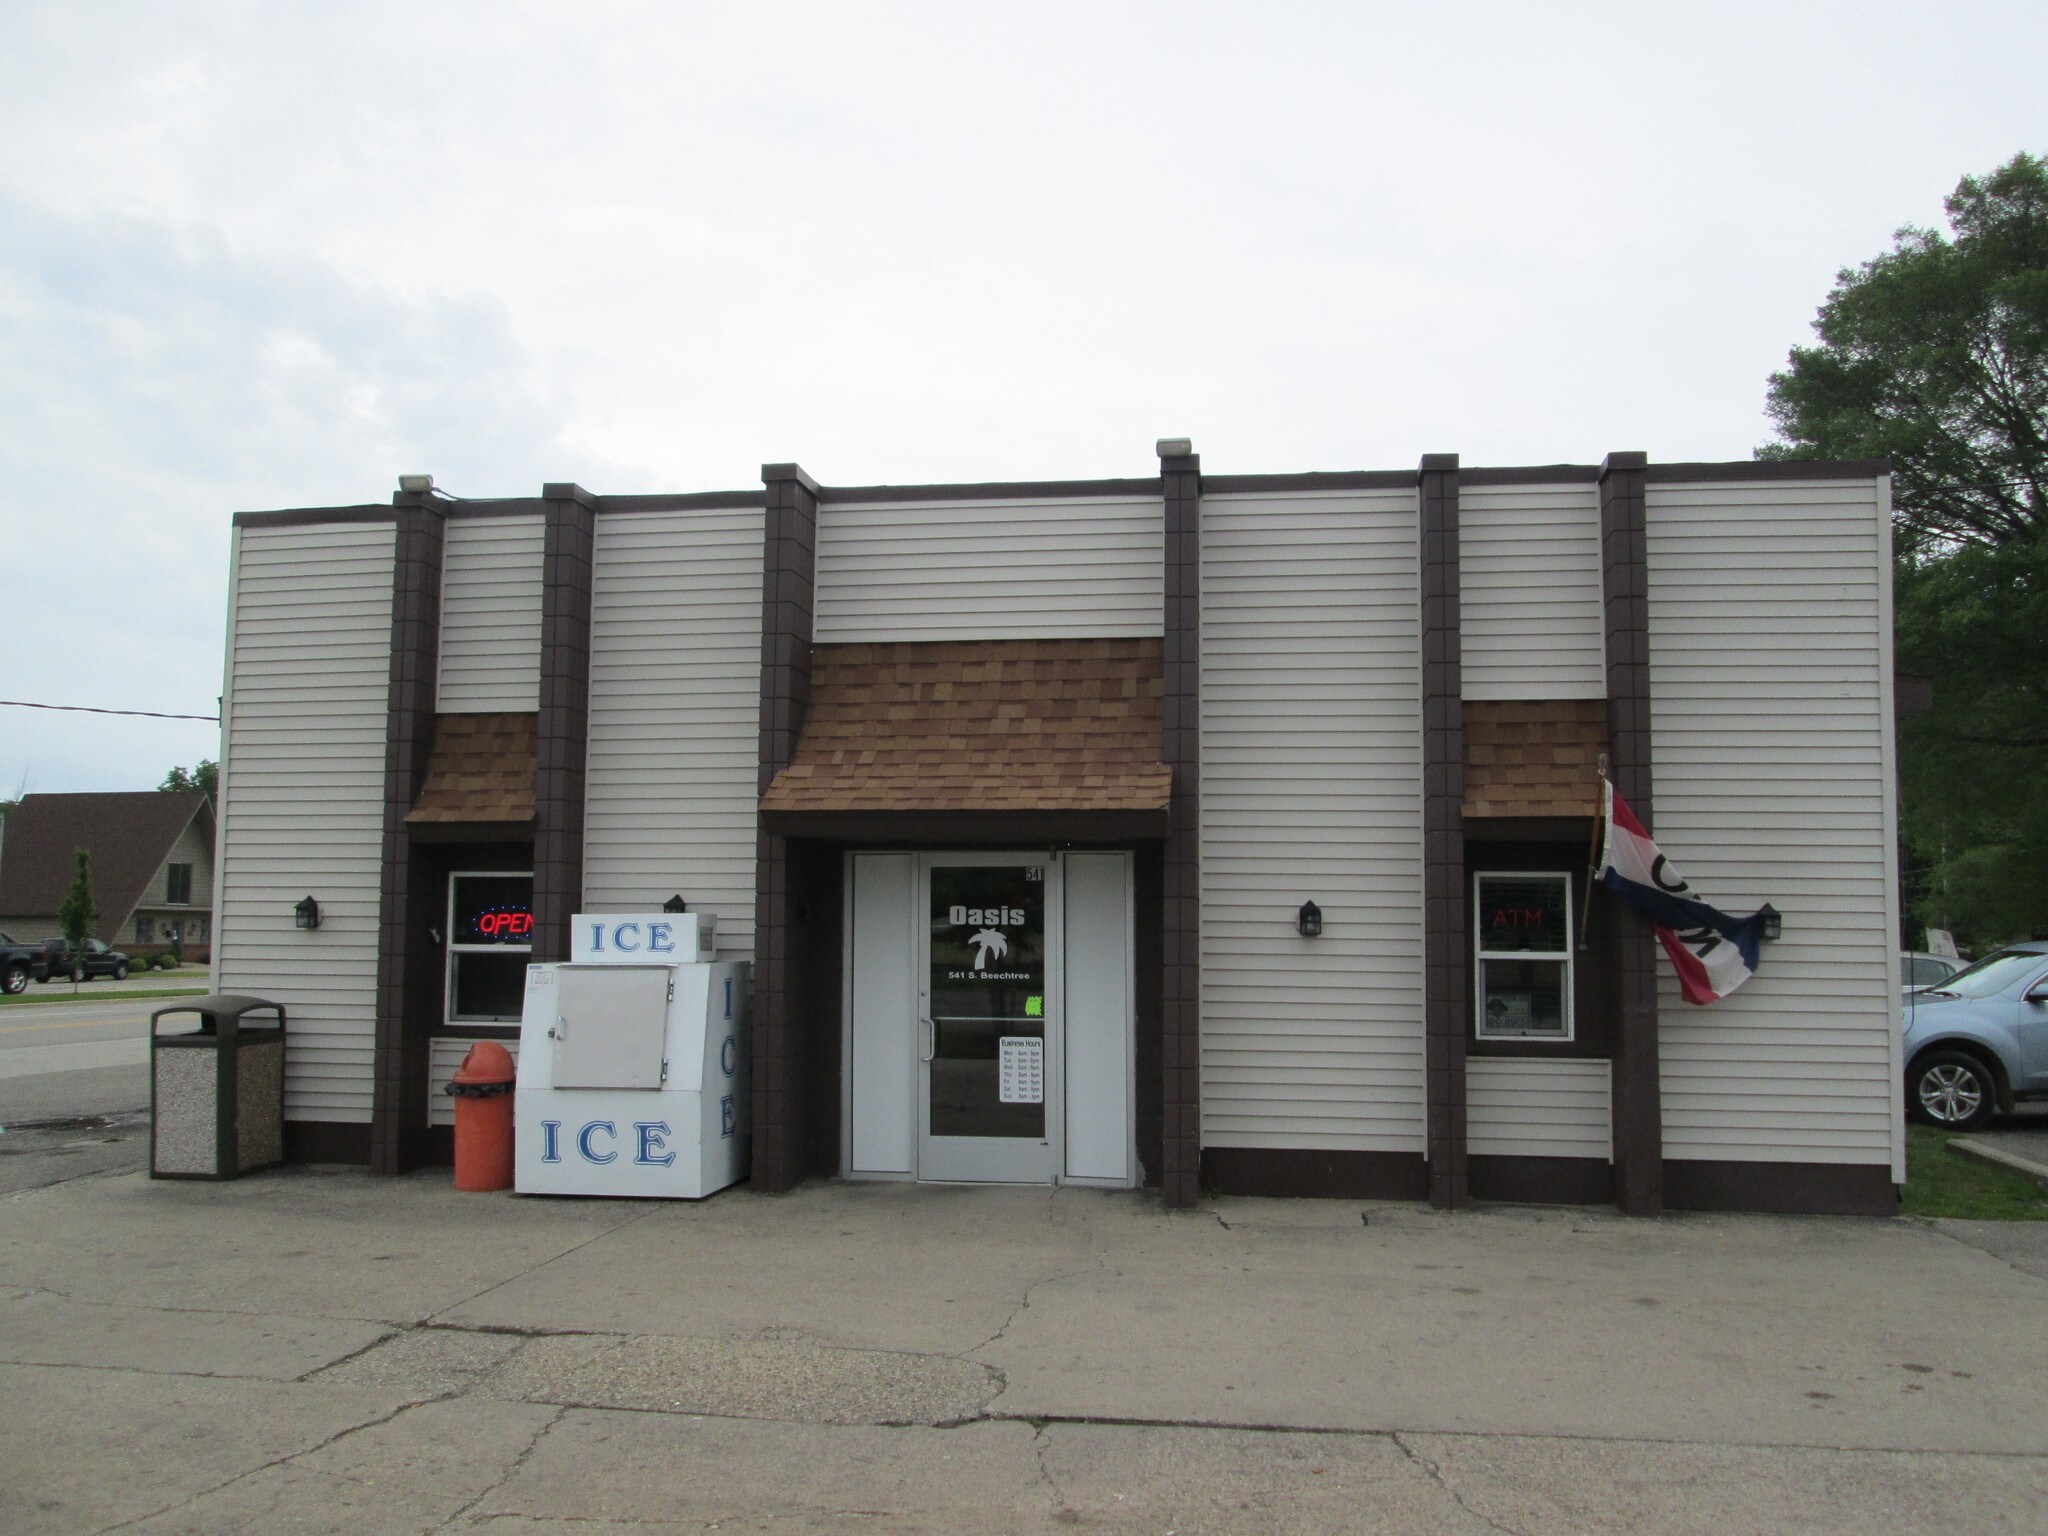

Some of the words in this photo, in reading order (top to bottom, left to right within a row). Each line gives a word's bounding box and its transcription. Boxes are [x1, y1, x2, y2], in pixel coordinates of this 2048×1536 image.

[1026, 867, 1044, 880] 541
[949, 905, 1025, 926] Oasis
[1492, 908, 1544, 928] ATM
[590, 922, 676, 953] ICE
[948, 971, 965, 979] 541
[968, 971, 978, 979] S.
[980, 971, 1030, 980] Beechtree
[1001, 1039, 1024, 1047] Business
[1025, 1039, 1041, 1047] Hours
[720, 977, 736, 1139] ICE
[541, 1120, 676, 1168] ICE
